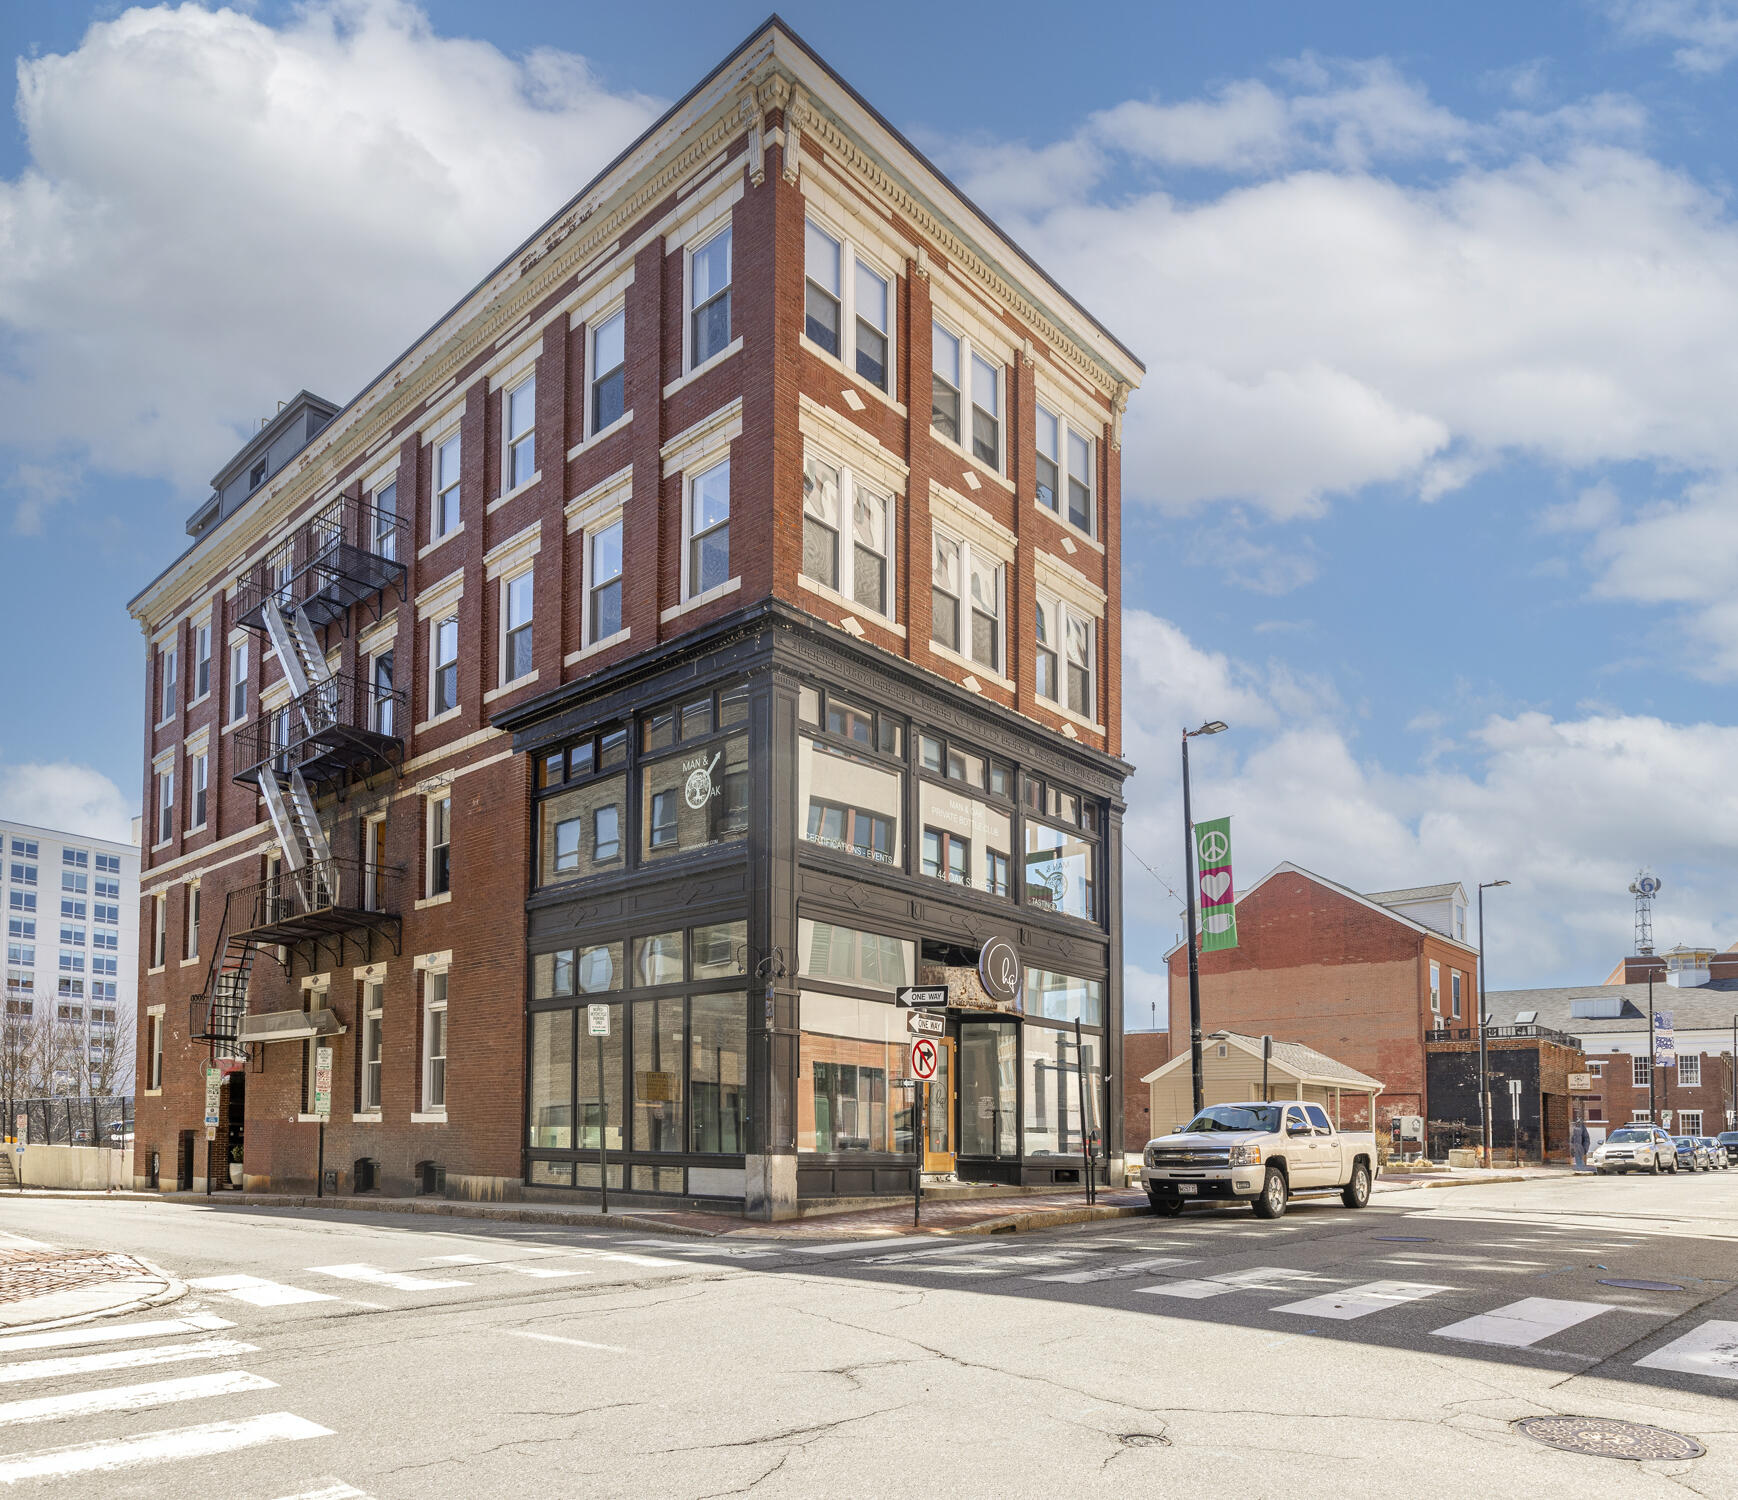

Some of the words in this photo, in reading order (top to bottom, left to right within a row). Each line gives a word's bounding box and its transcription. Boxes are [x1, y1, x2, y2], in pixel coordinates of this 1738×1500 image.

[682, 757, 701, 772] MAN
[702, 755, 709, 766] &
[806, 832, 862, 856] CERTIFICATIONS
[866, 849, 893, 865] EVENTS
[937, 869, 946, 882] 44
[948, 872, 965, 886] OAK
[1641, 878, 1654, 892] 6
[911, 993, 926, 1001] ONE
[928, 992, 942, 1000] WAY
[918, 1019, 929, 1029] ONE
[930, 1021, 941, 1030] WAY
